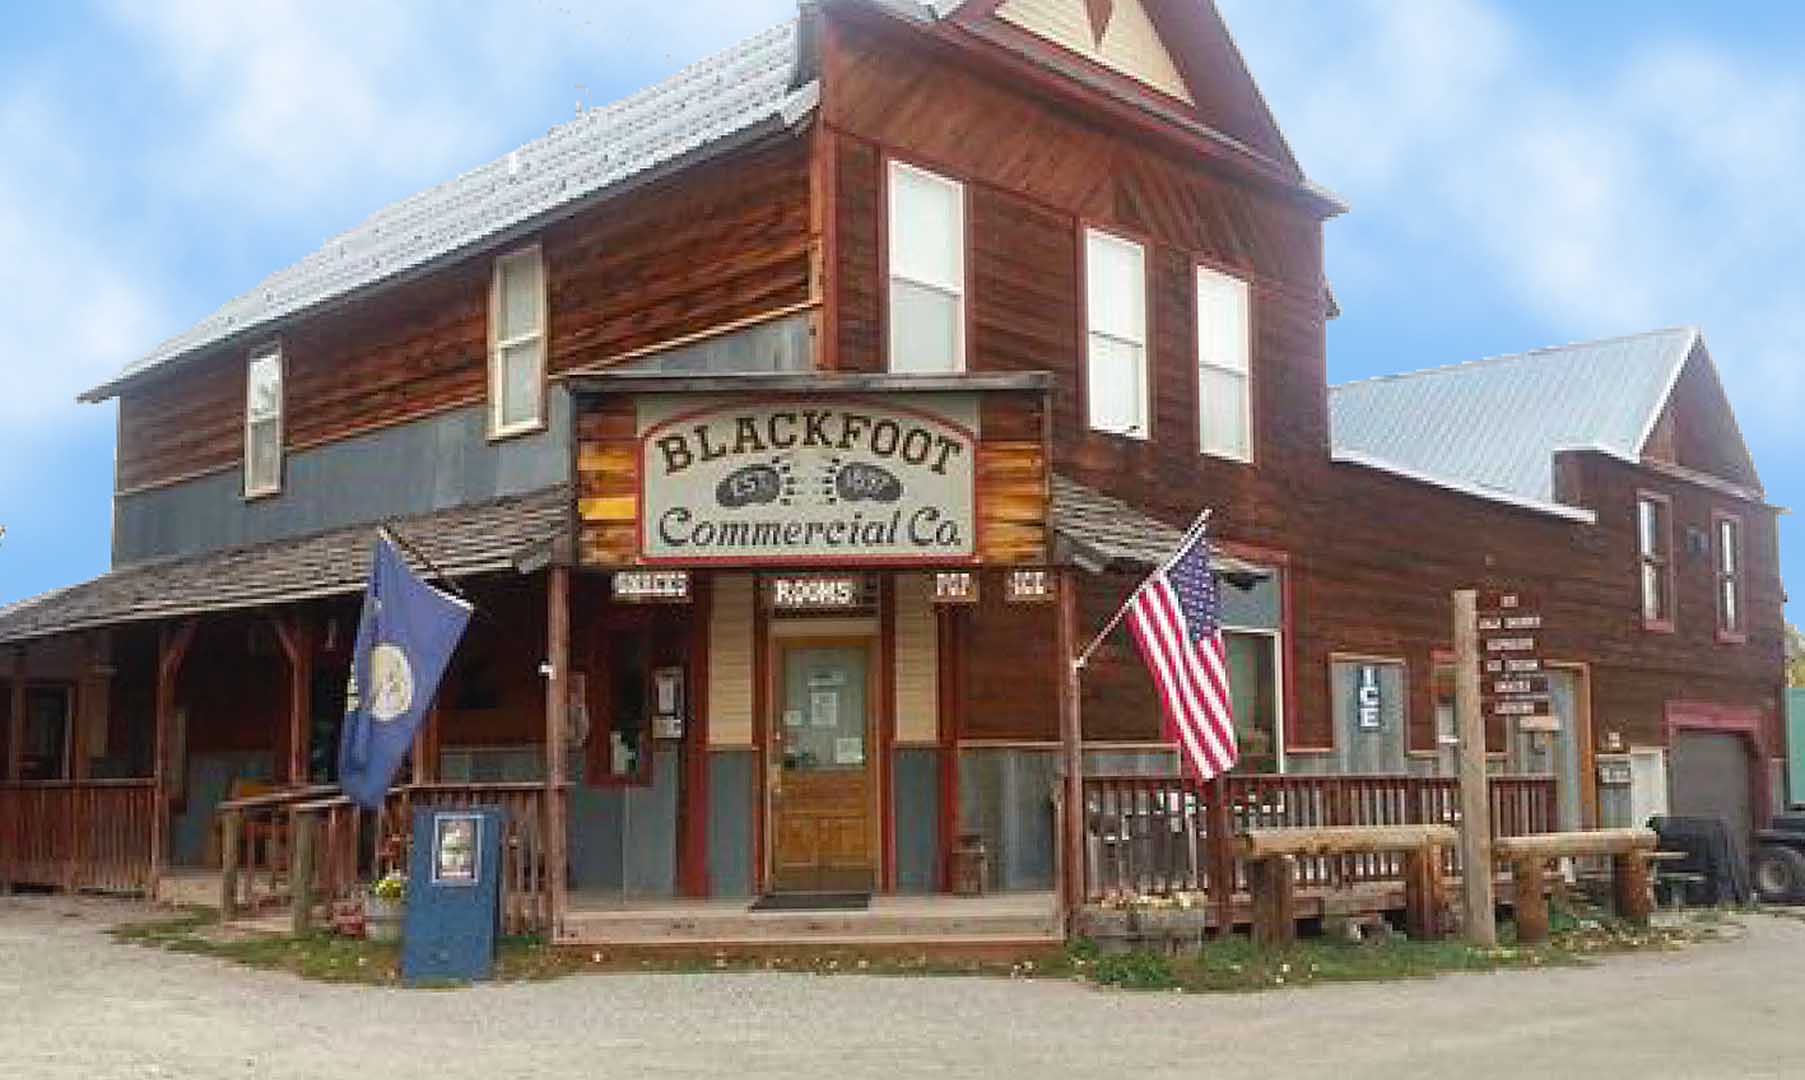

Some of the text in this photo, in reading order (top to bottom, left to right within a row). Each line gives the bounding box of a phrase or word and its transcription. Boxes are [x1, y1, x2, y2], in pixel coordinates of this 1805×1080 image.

[656, 408, 963, 476] BLACKFOOT
[660, 506, 900, 547] Commercial
[775, 578, 853, 605] ROOMS
[1359, 665, 1380, 727] ICE
